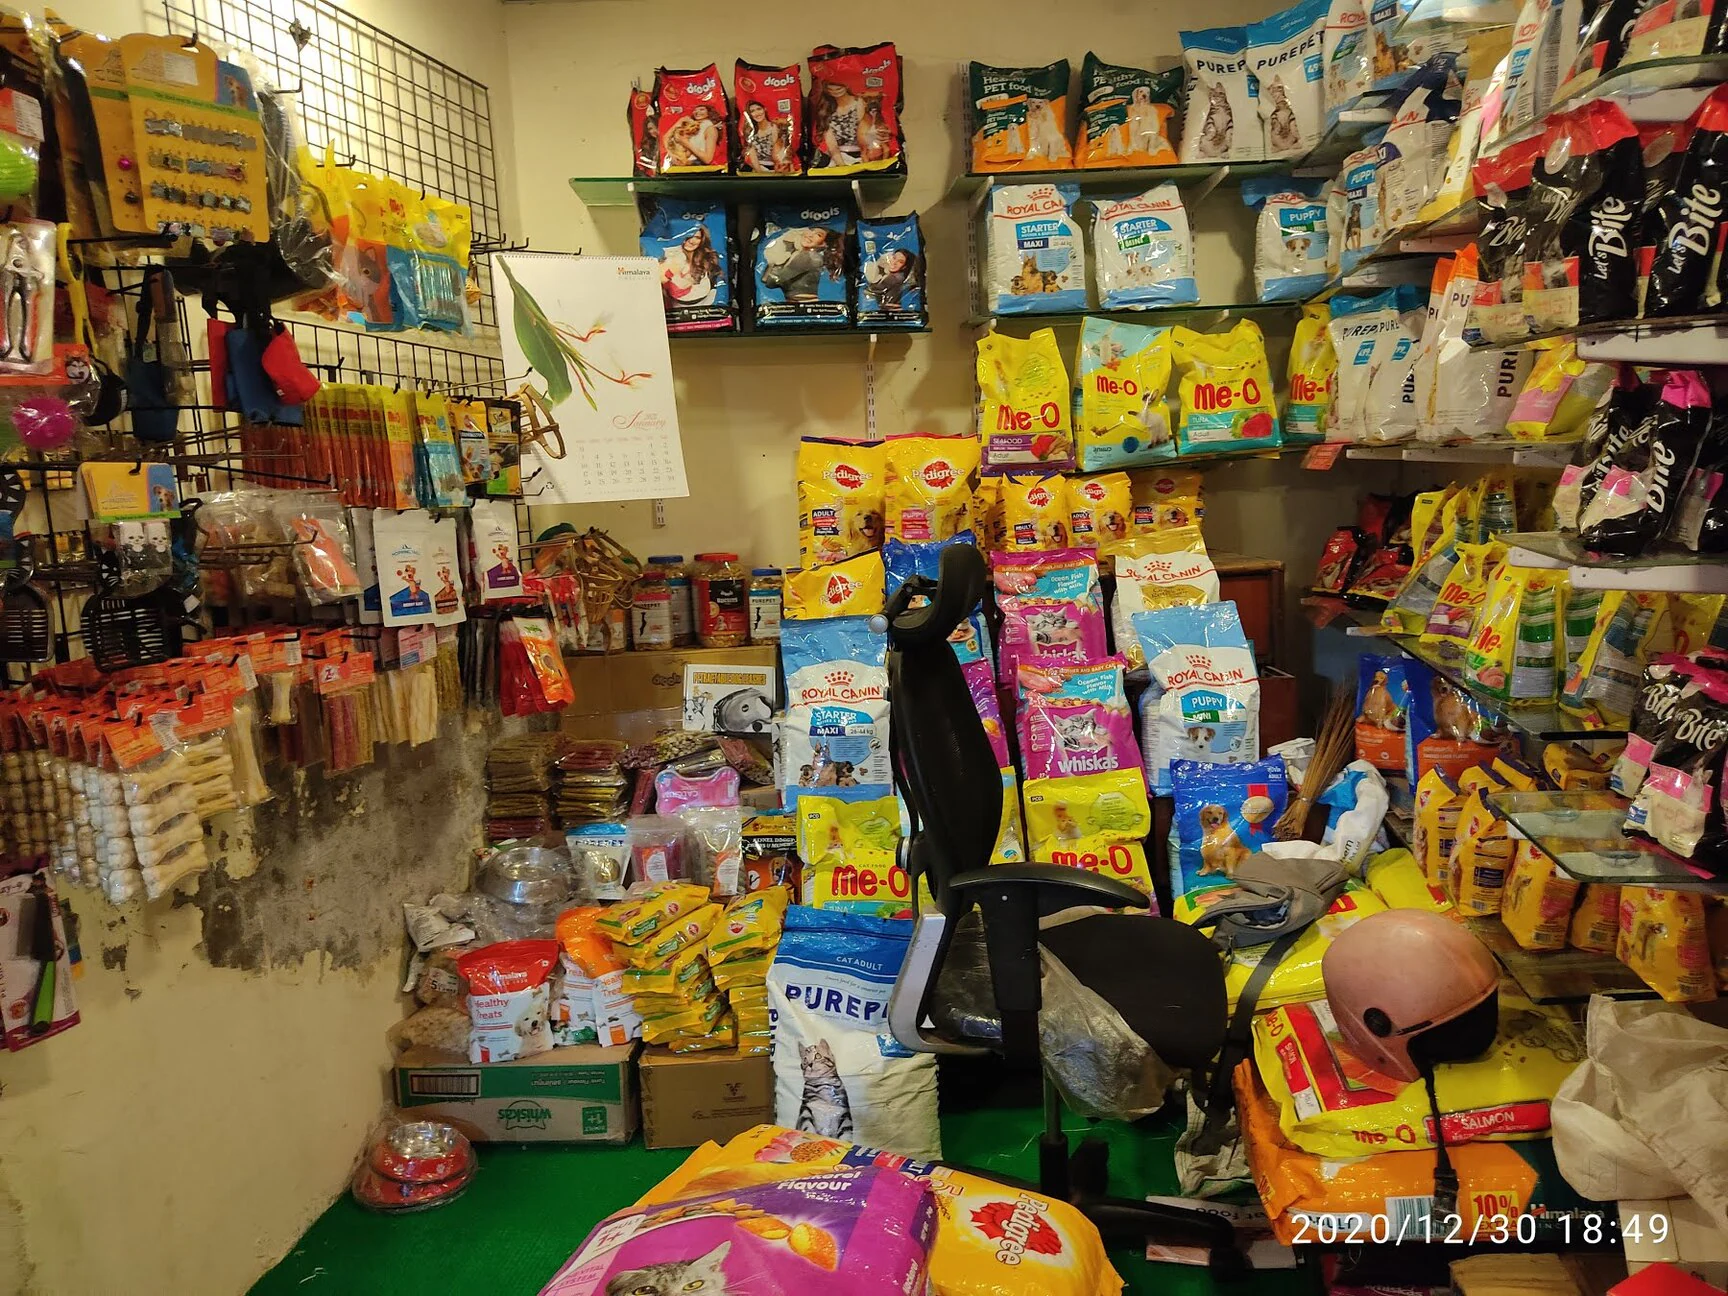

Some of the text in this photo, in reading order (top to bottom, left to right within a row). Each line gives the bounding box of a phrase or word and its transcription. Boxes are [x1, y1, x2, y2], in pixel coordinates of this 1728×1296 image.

[1257, 30, 1325, 69] PUREPET
[687, 77, 716, 95] drools
[763, 73, 795, 87] drools
[1008, 83, 1032, 95] food
[800, 206, 840, 221] drools
[1007, 202, 1040, 214] ROYAL
[1290, 210, 1320, 222] PUPPY
[1021, 224, 1059, 233] STARTER
[1120, 220, 1157, 233] STARTER
[1667, 184, 1723, 274] Let's Bite
[1588, 196, 1632, 280] Let's Bite
[822, 466, 873, 484] Pedigree
[912, 466, 965, 482] Pedigree
[1162, 566, 1201, 580] CANIN
[1077, 678, 1098, 686] Ocean
[1167, 669, 1202, 686] ROYAL
[802, 686, 880, 700] ROYAL CANIN
[1191, 697, 1222, 708] PUPPY
[816, 711, 857, 720] STARTER
[817, 727, 838, 735] MAXI
[866, 728, 874, 736] kg
[1675, 708, 1721, 751] Bite
[1058, 754, 1119, 773] whiskas
[836, 956, 883, 971] CAT ADULT
[498, 1108, 552, 1123] whiskas
[1461, 1110, 1515, 1130] SALMON
[777, 1180, 852, 1192] Flavour
[1473, 1192, 1519, 1218] 10%
[1530, 1203, 1606, 1220] Himalaya
[995, 1192, 1049, 1266] Pedigree
[597, 1231, 626, 1248] 1+
